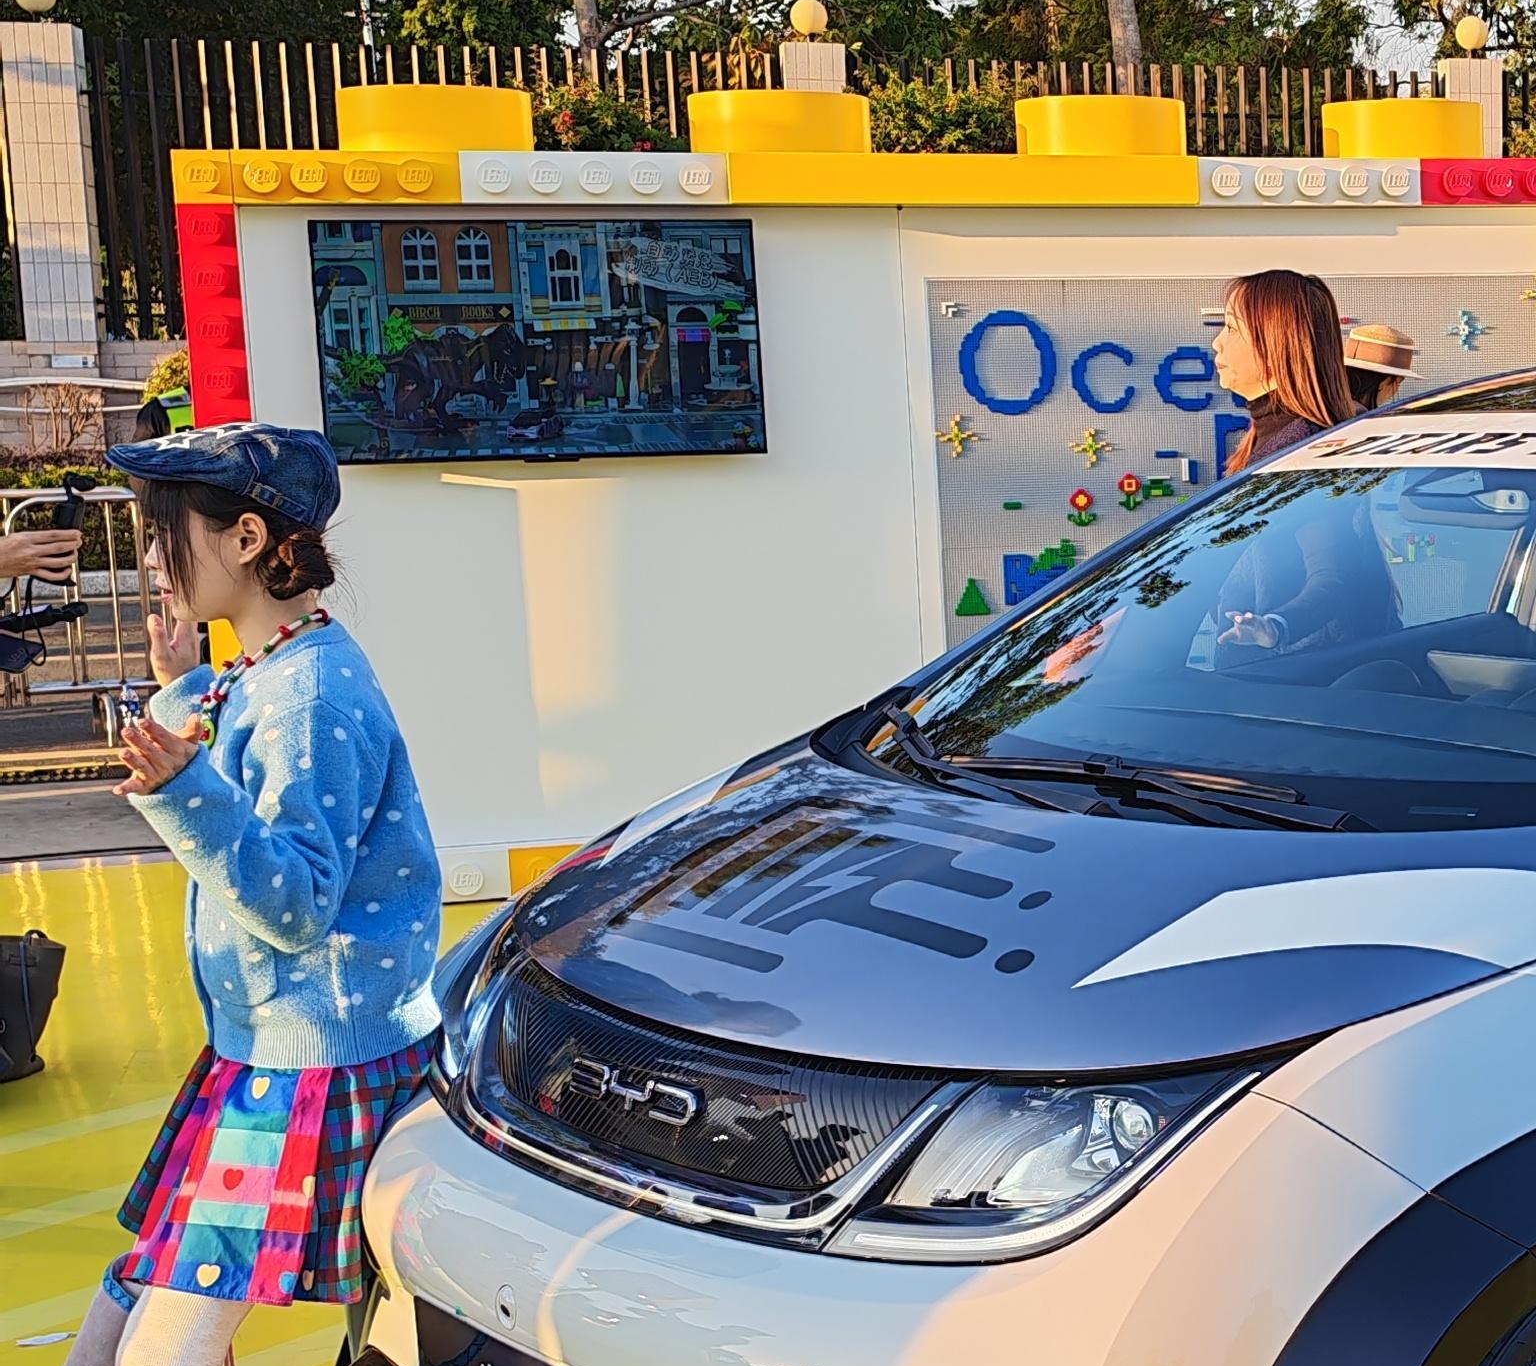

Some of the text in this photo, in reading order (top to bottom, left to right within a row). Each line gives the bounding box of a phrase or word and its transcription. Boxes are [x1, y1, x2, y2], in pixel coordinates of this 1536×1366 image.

[187, 166, 217, 183] LEGO
[297, 166, 325, 183] LEGO
[349, 166, 377, 184] LEGO
[402, 167, 429, 184] LEGO
[480, 167, 711, 186] LEGO LEGO LEGO LEGO LEGO
[1217, 172, 1410, 188] LEGO LEGO LEGO LEGO LEGO
[408, 305, 494, 319] BIRCH BOOKS
[958, 309, 1248, 415] Oce
[569, 1056, 697, 1127] BYD
